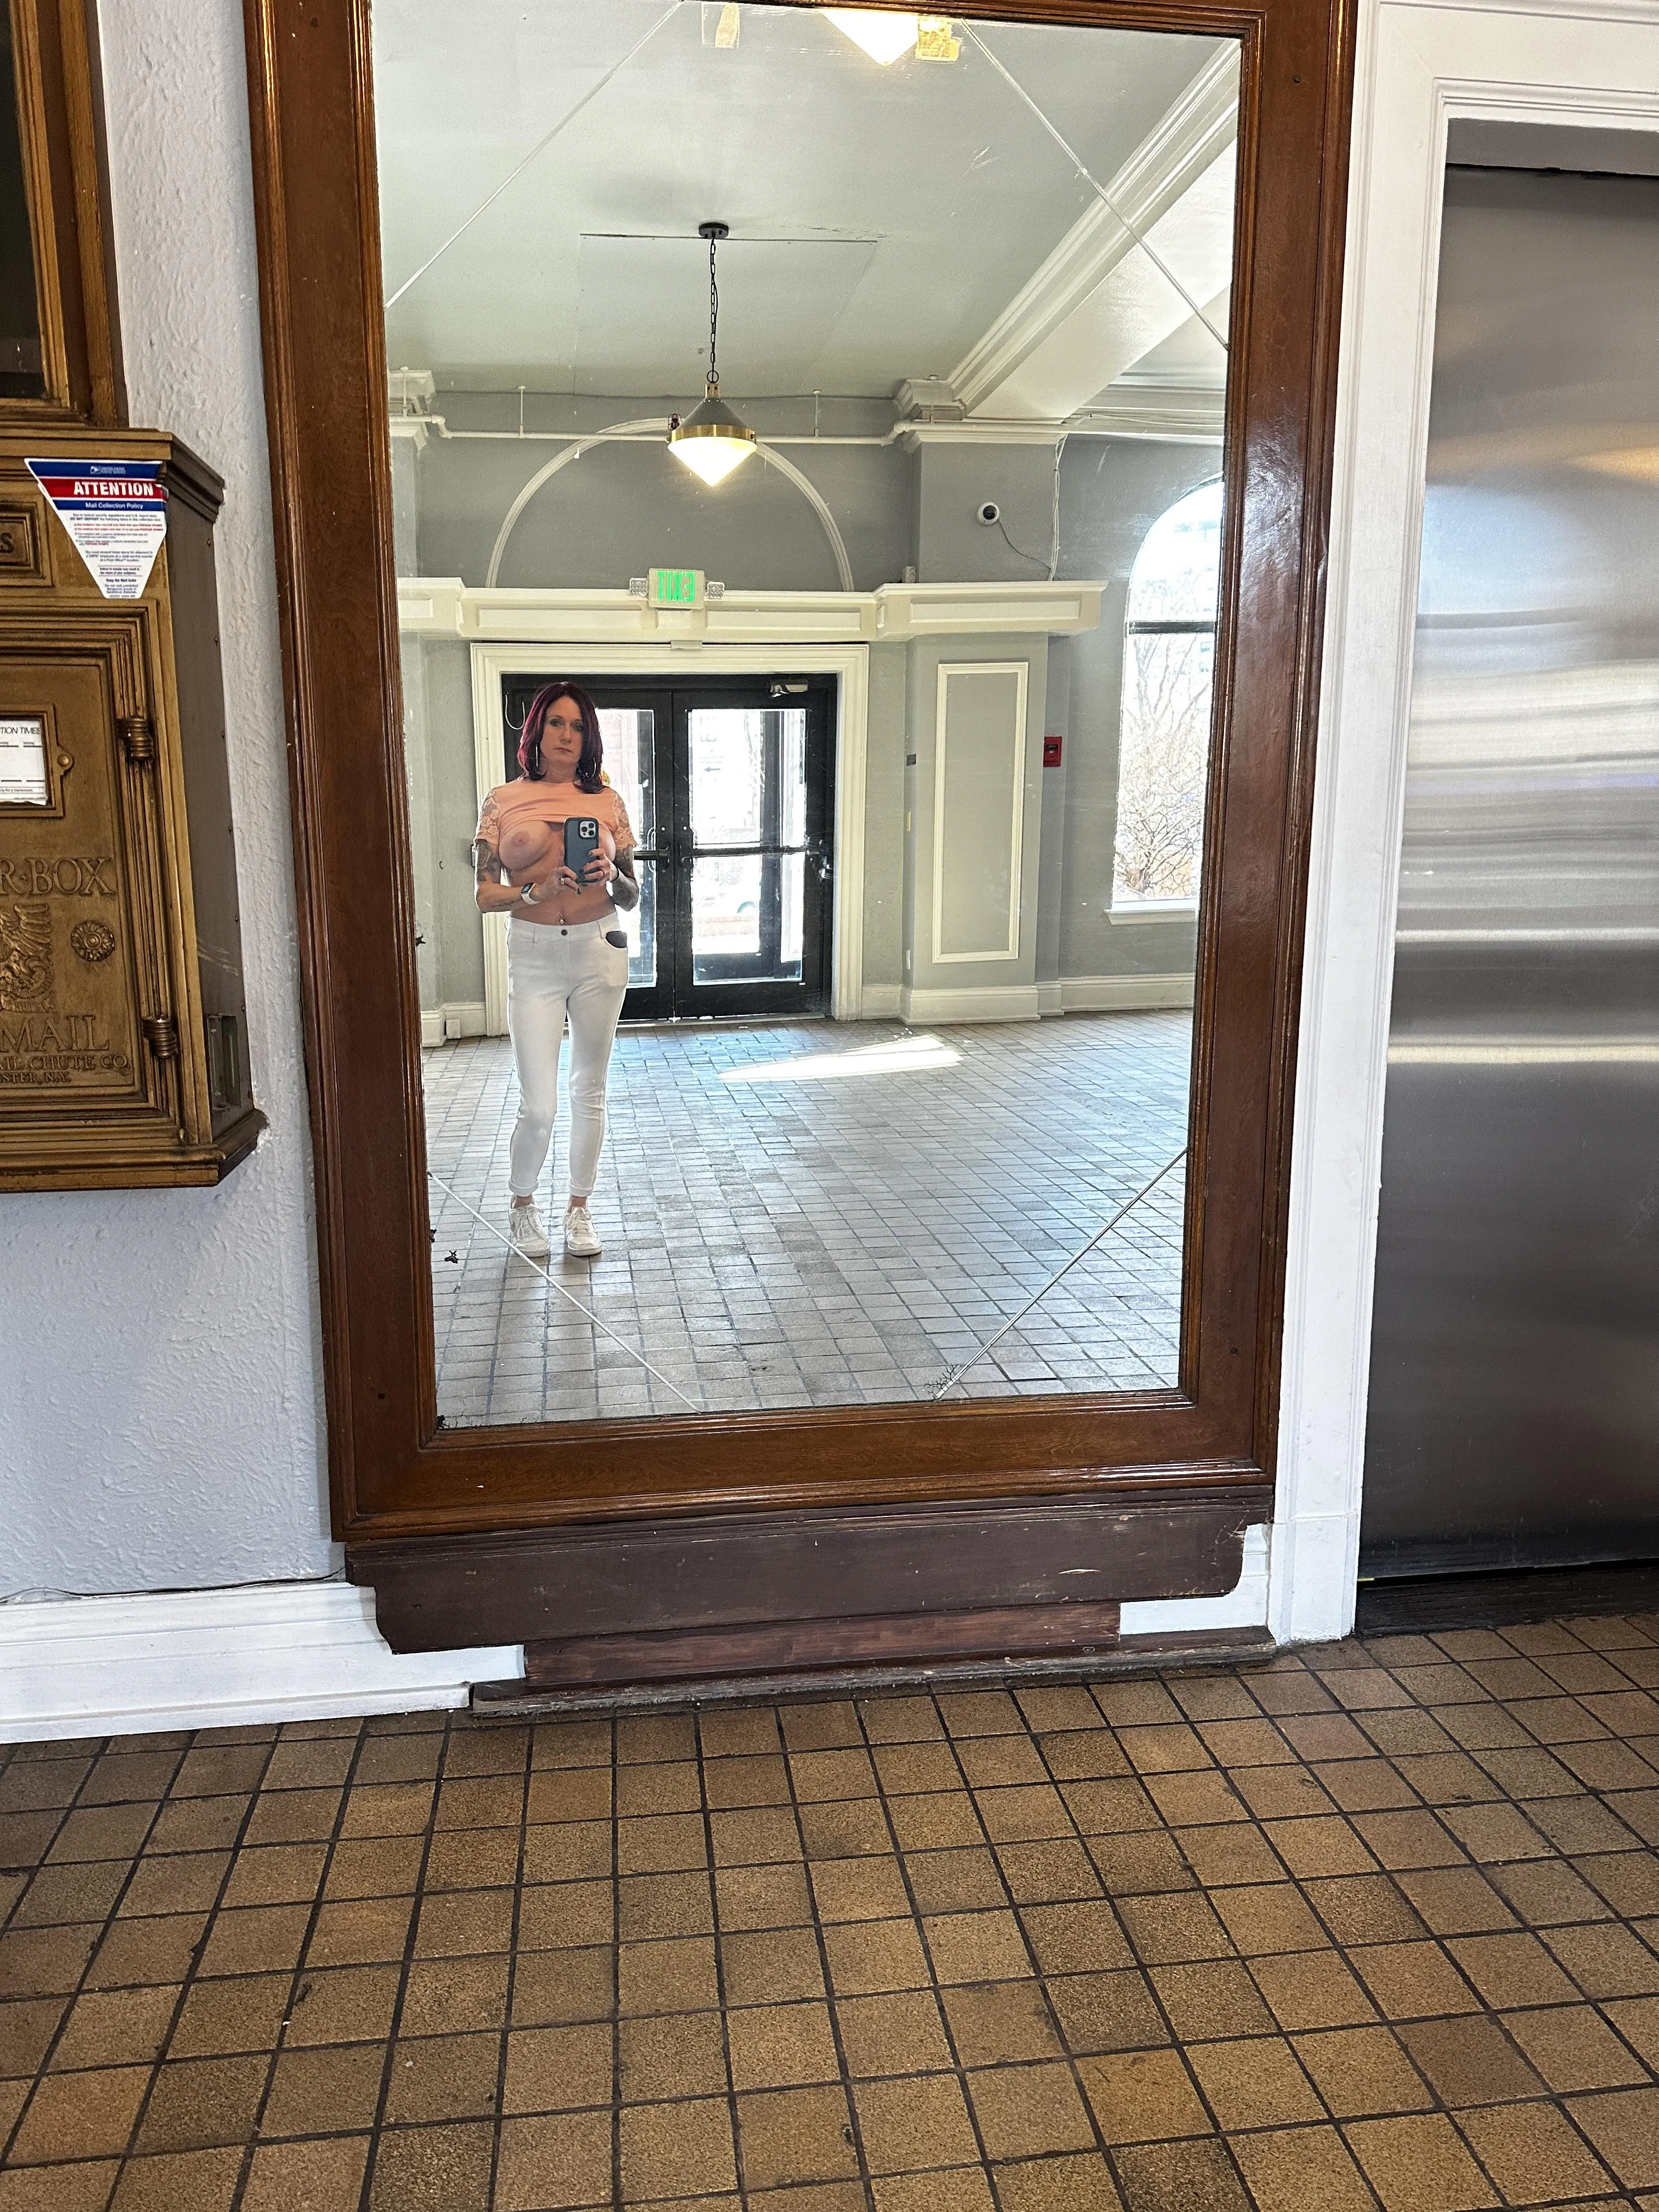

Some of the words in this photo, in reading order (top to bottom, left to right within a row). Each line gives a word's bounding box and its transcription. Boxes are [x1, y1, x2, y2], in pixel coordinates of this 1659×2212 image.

[74, 481, 154, 496] ATTENTION
[20, 726, 40, 735] TIMES
[0, 1015, 110, 1052] MAIL
[30, 1054, 96, 1071] CHUTE
[100, 1052, 131, 1069] CO.
[44, 1071, 72, 1083] N.Y.
